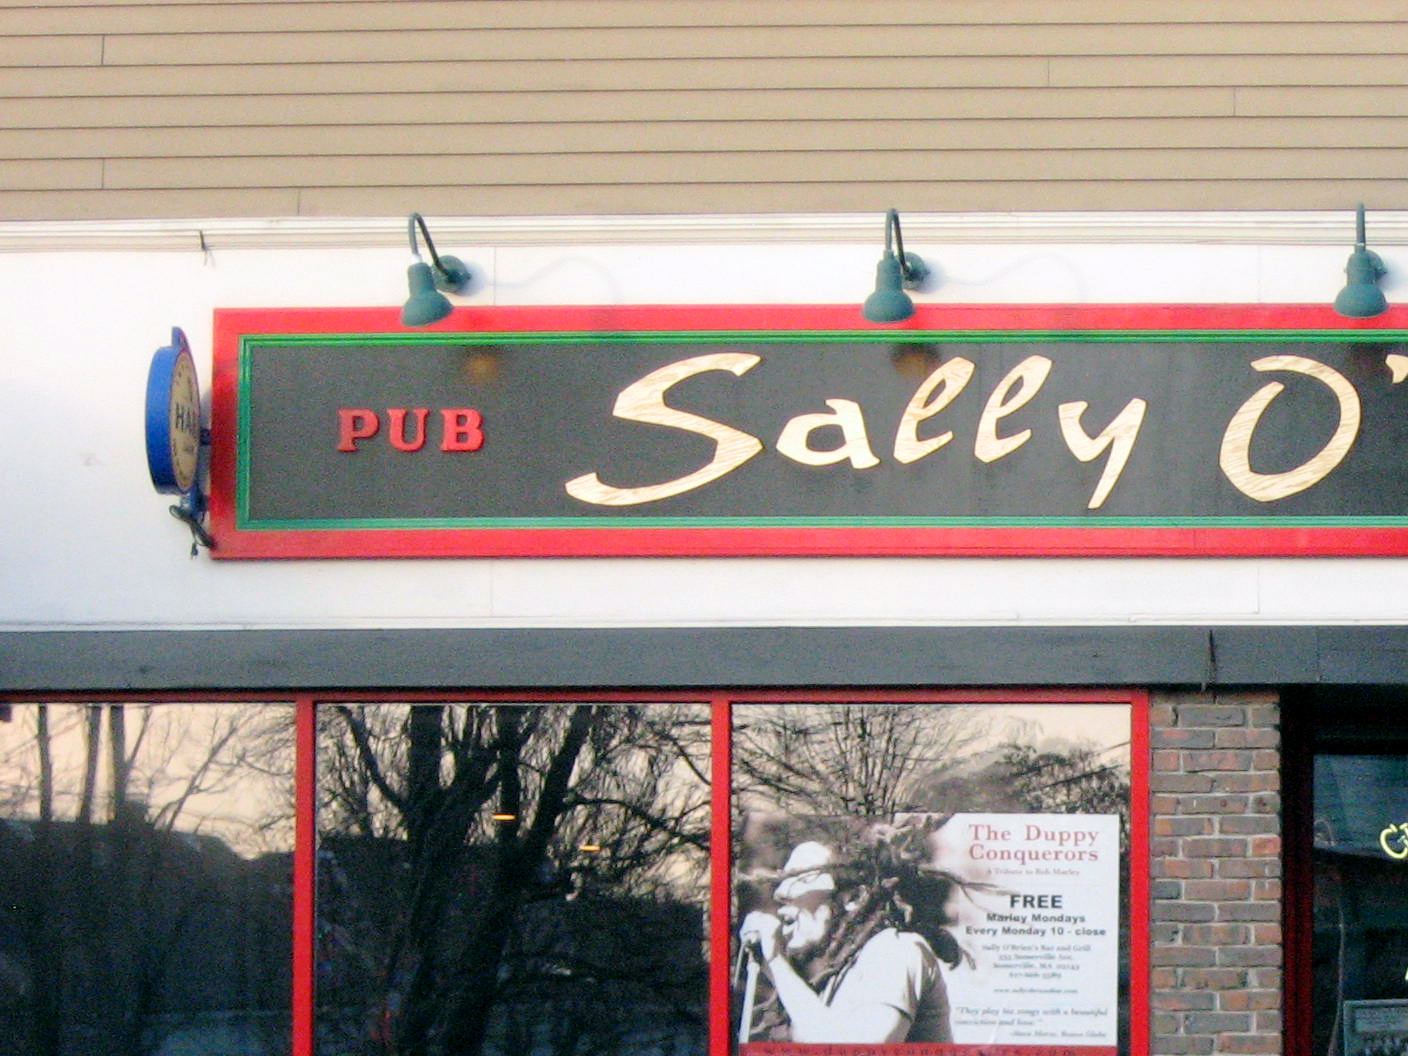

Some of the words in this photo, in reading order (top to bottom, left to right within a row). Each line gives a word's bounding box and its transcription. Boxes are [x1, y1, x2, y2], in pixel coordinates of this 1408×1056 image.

[336, 406, 486, 453] PUB
[563, 351, 1148, 510] Sally
[968, 823, 1012, 841] The
[1025, 823, 1100, 847] Duppy
[968, 843, 1099, 866] Conquerors
[1010, 894, 1063, 909] FREE
[987, 912, 1027, 924] Marley
[1031, 913, 1086, 924] Mondays
[965, 926, 998, 937] Every
[1002, 926, 1046, 937] Monday
[1051, 926, 1064, 936] 10
[1075, 927, 1106, 936] close
